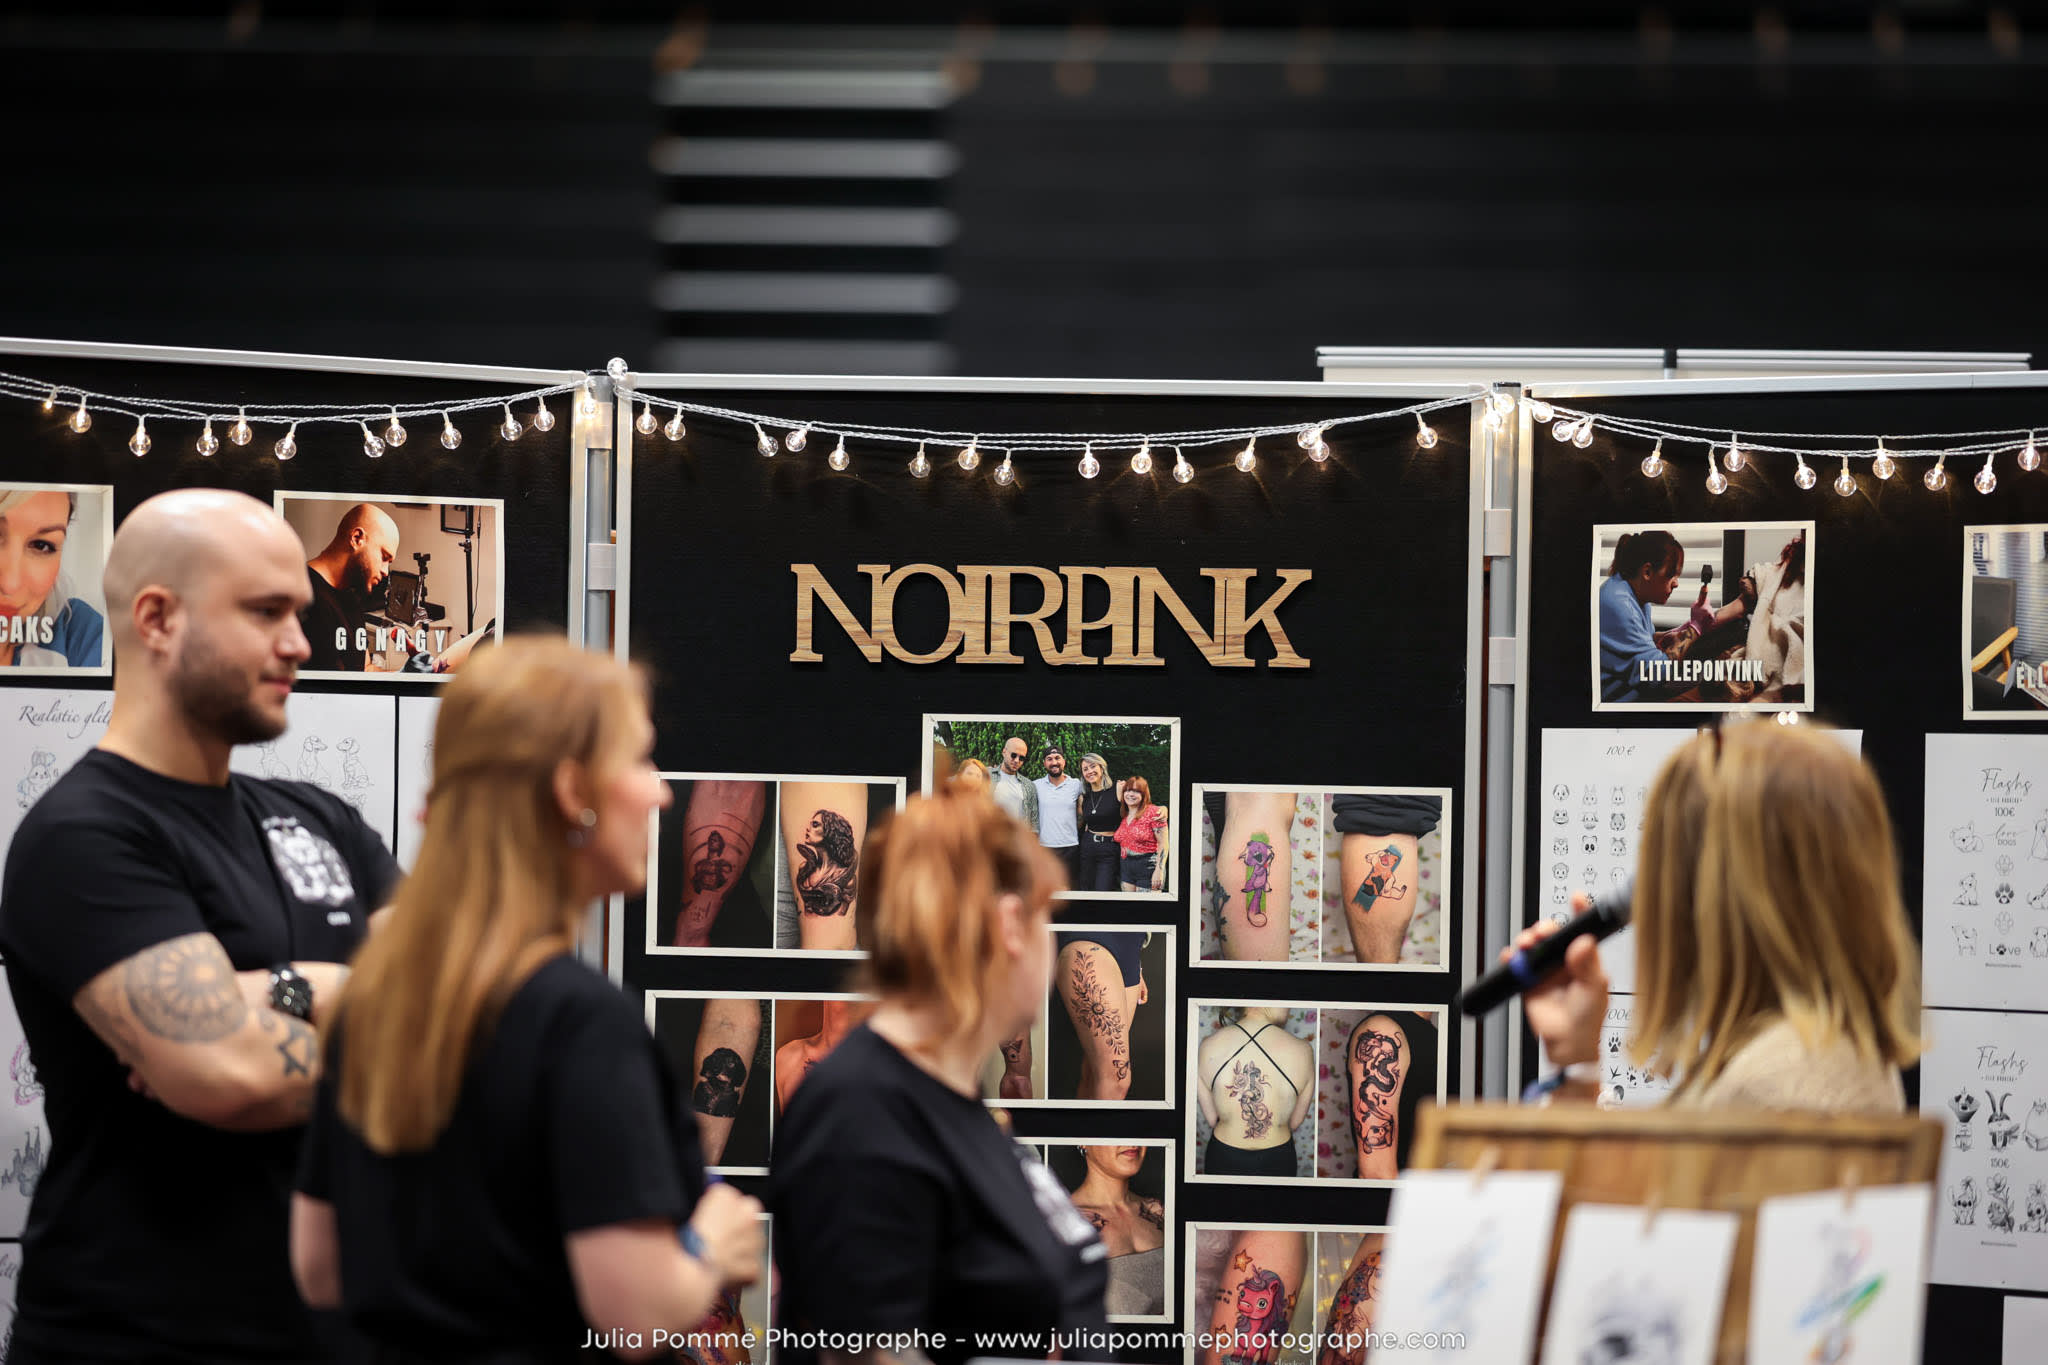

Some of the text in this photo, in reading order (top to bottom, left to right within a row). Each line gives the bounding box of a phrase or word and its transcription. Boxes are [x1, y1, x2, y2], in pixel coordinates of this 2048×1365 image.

[789, 563, 1313, 668] NOIRPINK
[1639, 659, 1764, 682] LITTLEPONYINK
[18, 699, 80, 727] Realistic
[1980, 767, 2033, 796] Flashs
[1994, 806, 2016, 817] 100€
[1988, 943, 2022, 956] Lve
[1976, 1045, 2029, 1075] Flashs
